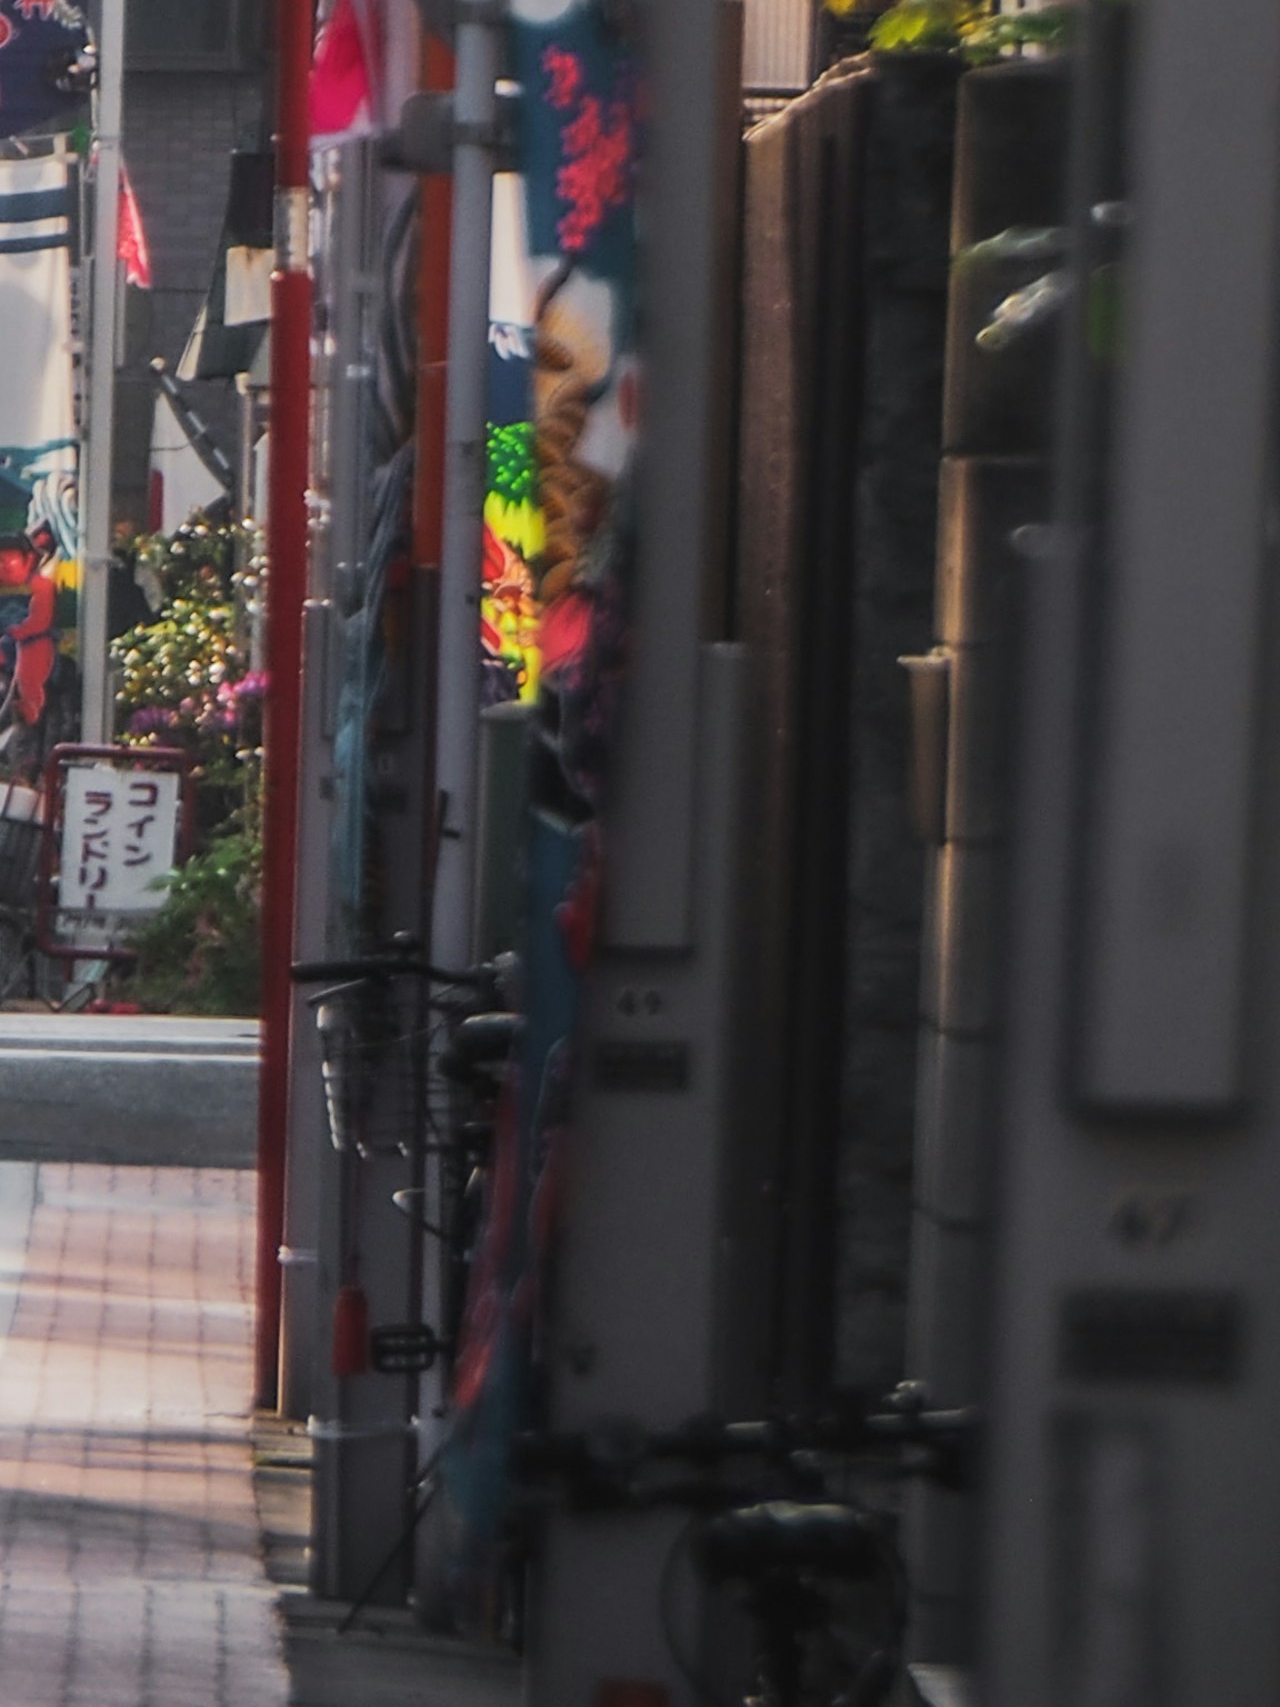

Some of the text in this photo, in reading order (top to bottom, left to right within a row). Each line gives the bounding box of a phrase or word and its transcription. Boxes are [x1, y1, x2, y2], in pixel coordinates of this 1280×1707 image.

[78, 790, 113, 910] ランドリー
[123, 781, 159, 868] コイン
